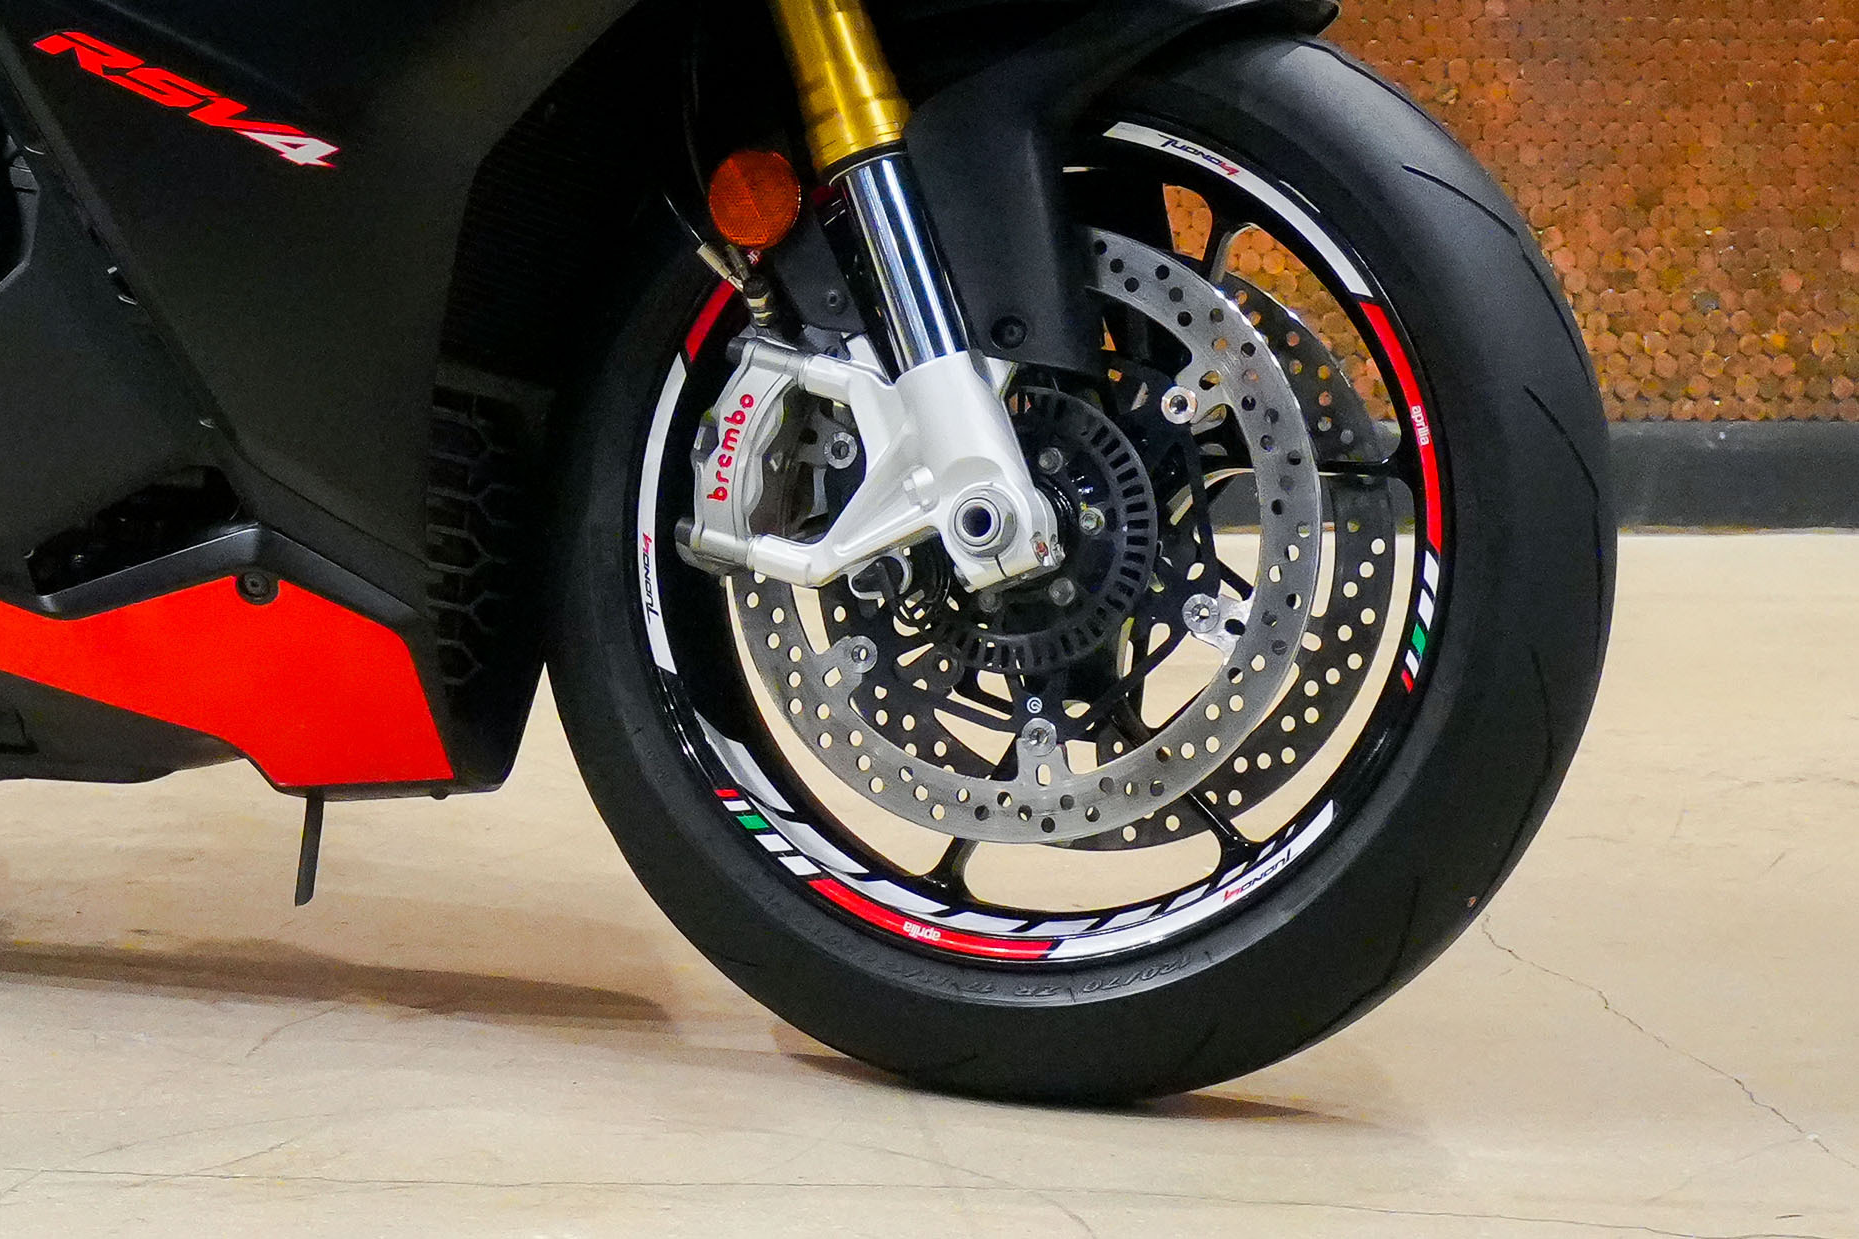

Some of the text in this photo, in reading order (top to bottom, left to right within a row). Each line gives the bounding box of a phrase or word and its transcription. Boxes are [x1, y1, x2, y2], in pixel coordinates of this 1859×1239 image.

[33, 31, 340, 168] RSV4
[706, 393, 754, 502] brembo
[1408, 403, 1431, 447] aprilia
[903, 919, 940, 943] aprilia
